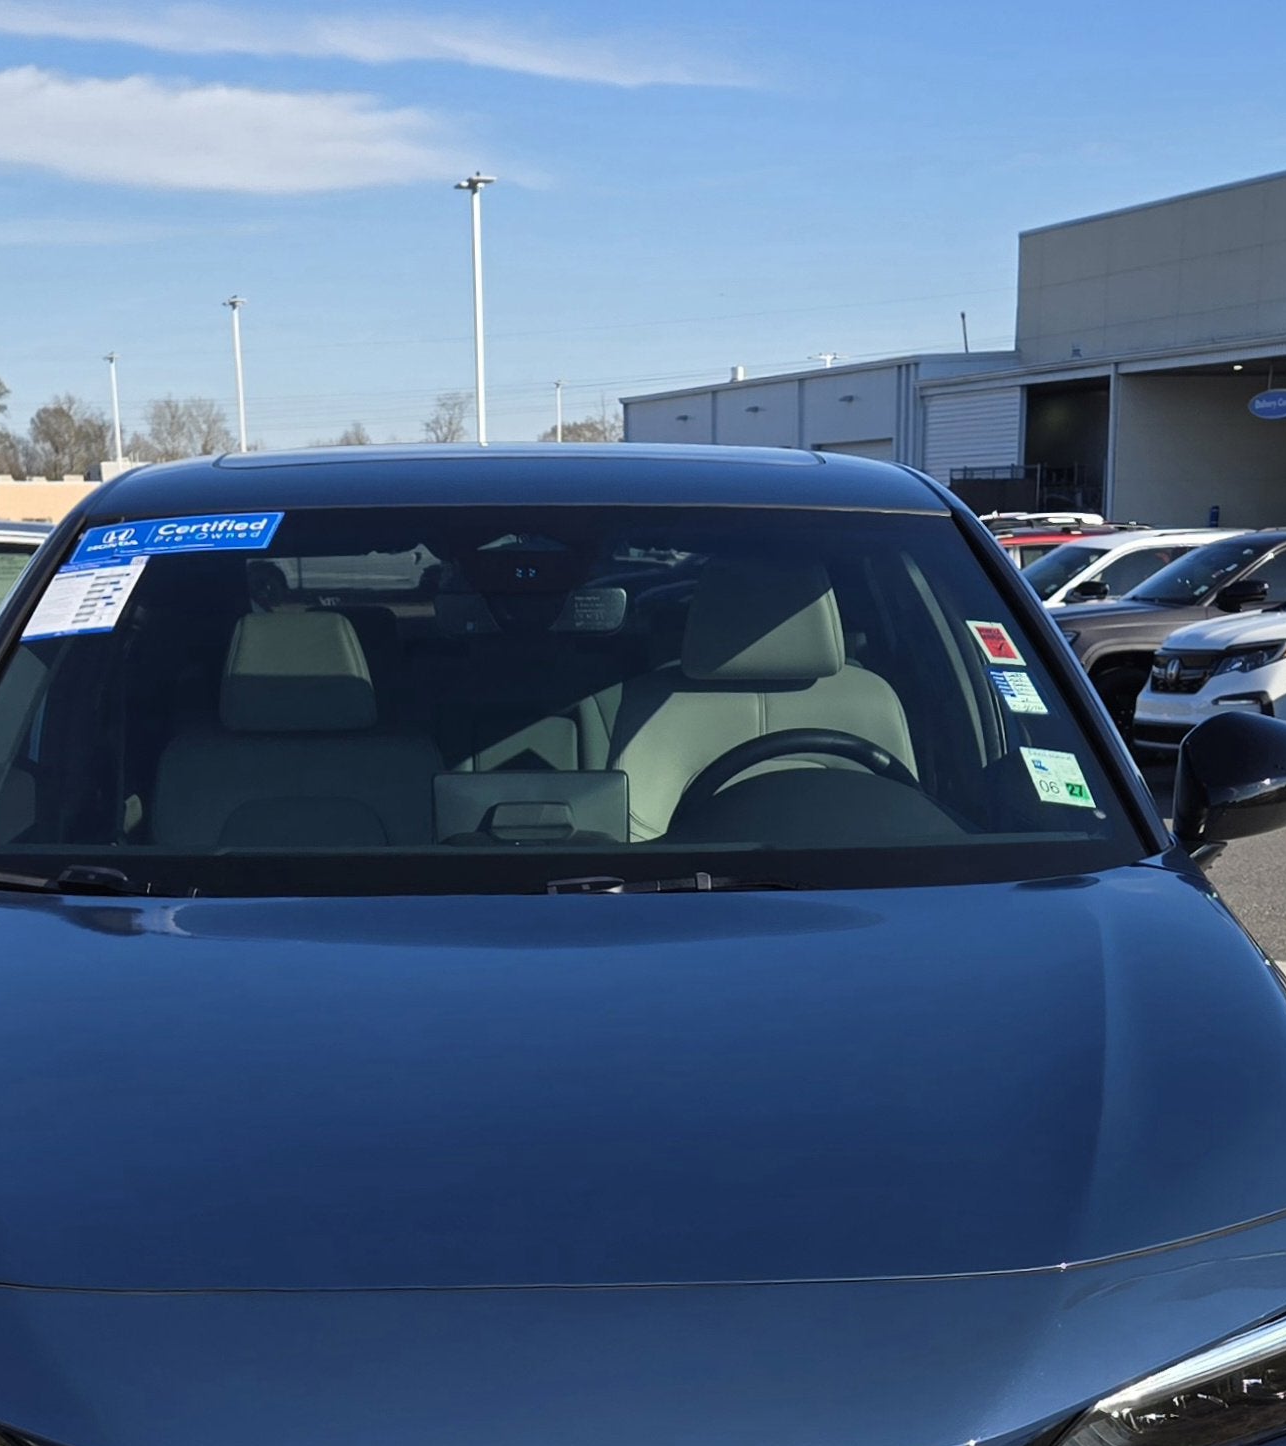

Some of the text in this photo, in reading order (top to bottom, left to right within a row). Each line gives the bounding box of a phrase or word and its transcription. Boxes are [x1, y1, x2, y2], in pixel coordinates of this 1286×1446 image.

[158, 518, 268, 536] Certified
[154, 530, 262, 543] Pre-Owned
[86, 539, 139, 551] HONDA
[1038, 779, 1084, 798] 06 27
